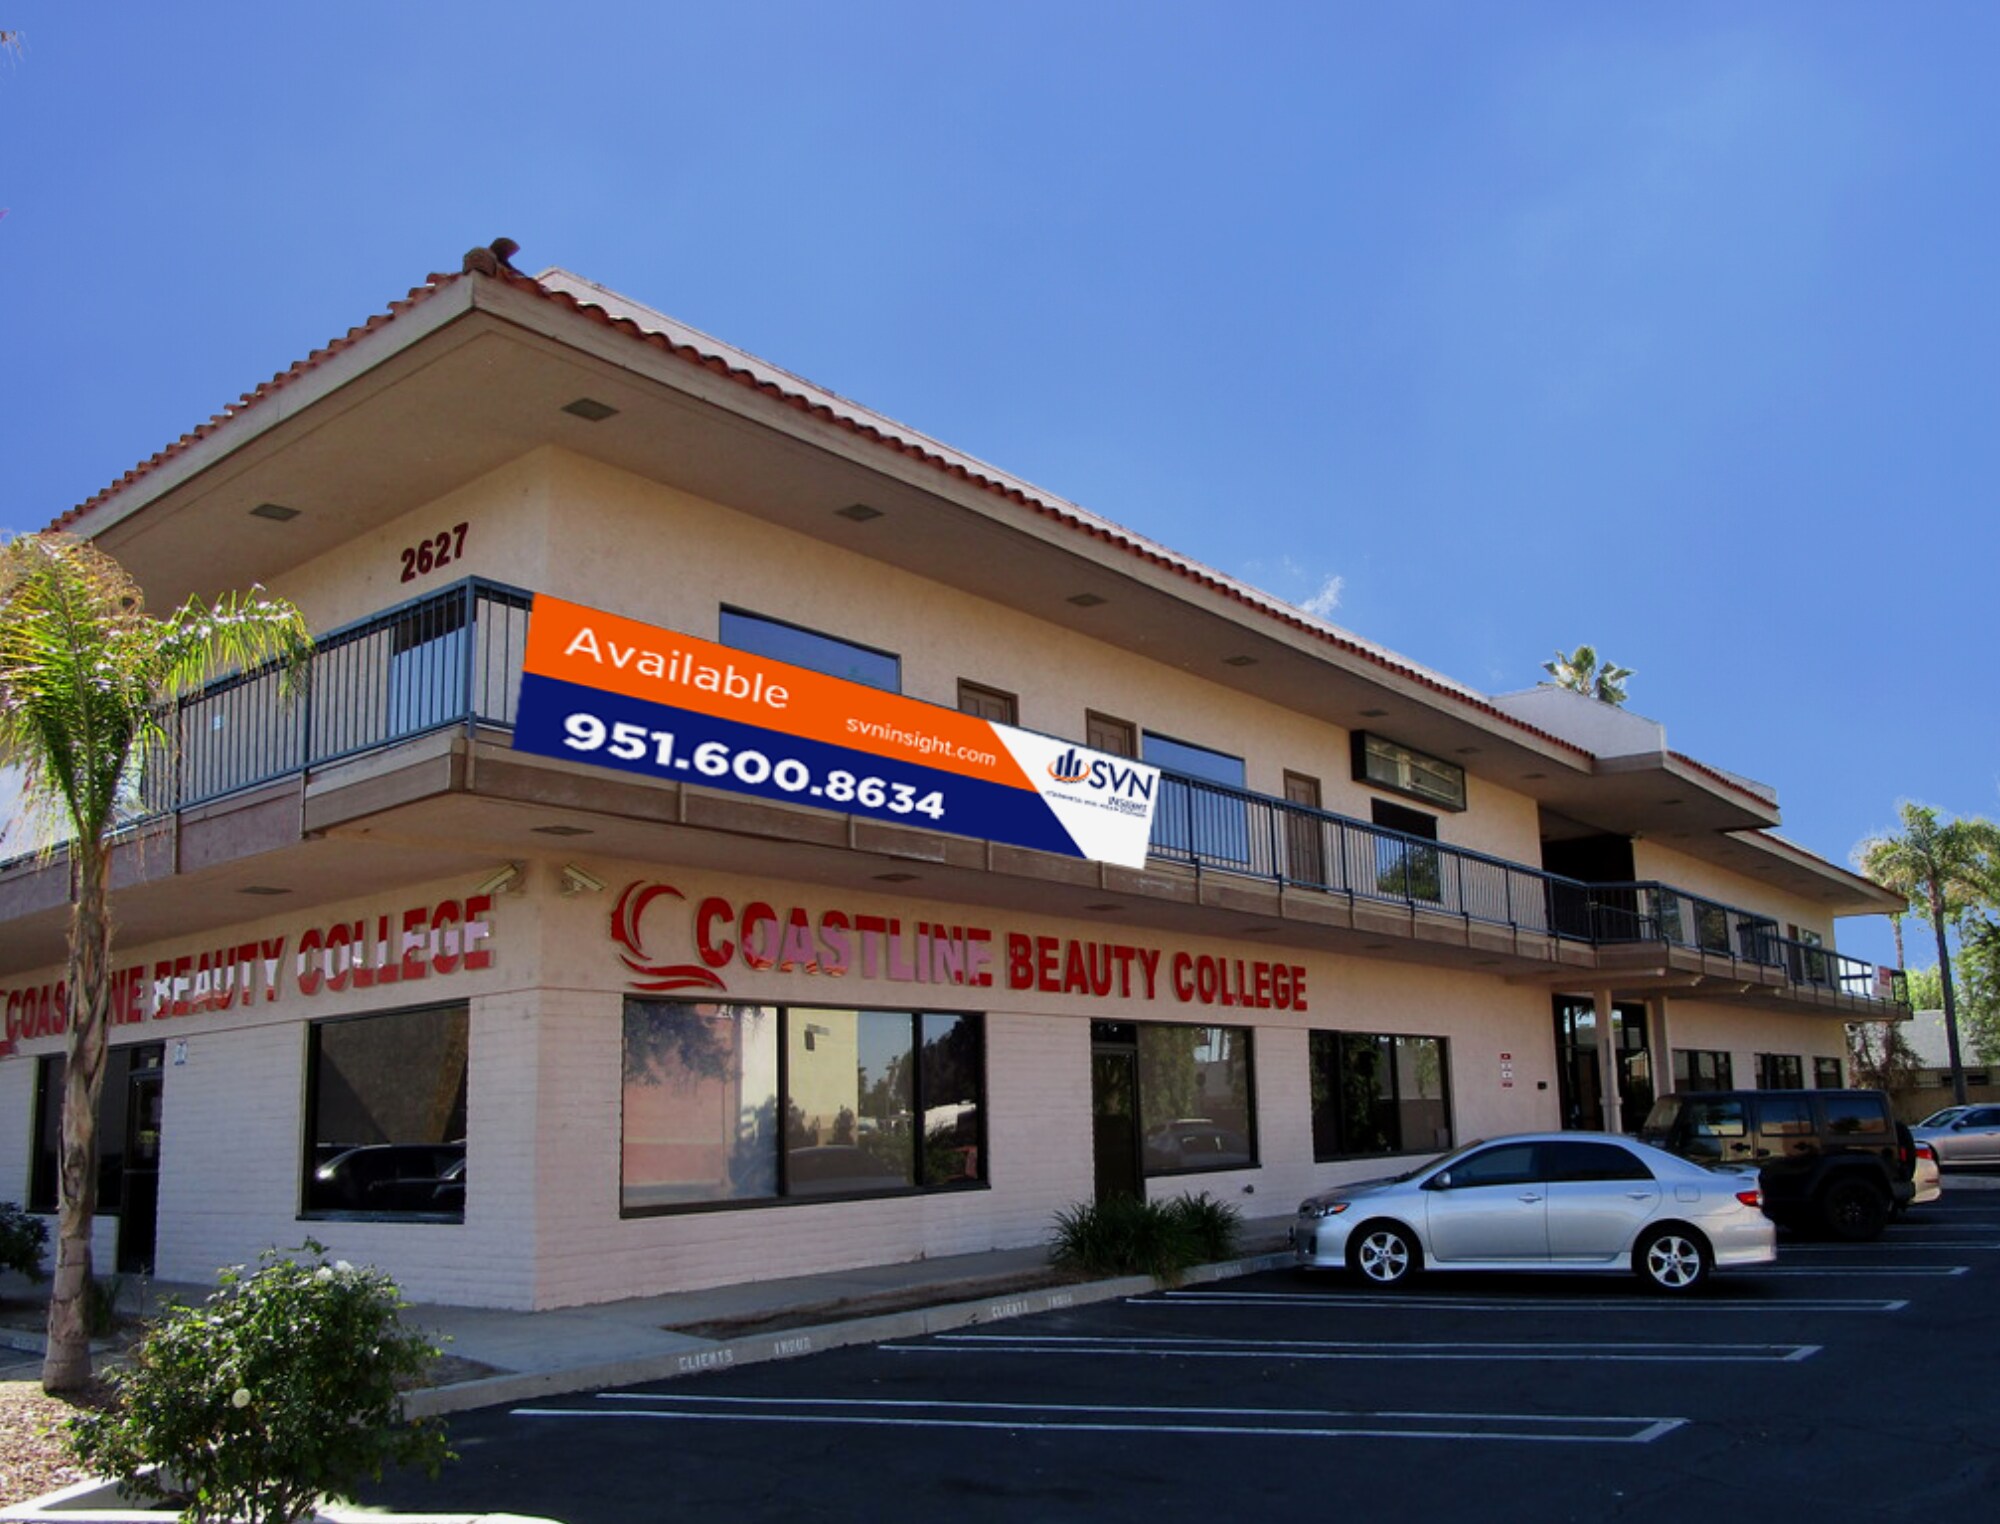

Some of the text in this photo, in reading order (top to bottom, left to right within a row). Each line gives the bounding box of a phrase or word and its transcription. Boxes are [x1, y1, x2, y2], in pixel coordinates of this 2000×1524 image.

[400, 521, 470, 583] 2627
[564, 626, 790, 711] Available
[562, 711, 945, 821] 951.600.8634
[846, 716, 998, 768] svninsight.com
[1088, 760, 1153, 800] SVN
[6, 894, 494, 1040] COASNE BEAUTY COLLEGE
[696, 897, 1308, 1012] COASTLINE BEAUTY COLLEGE
[678, 1349, 734, 1370] CLIENTS
